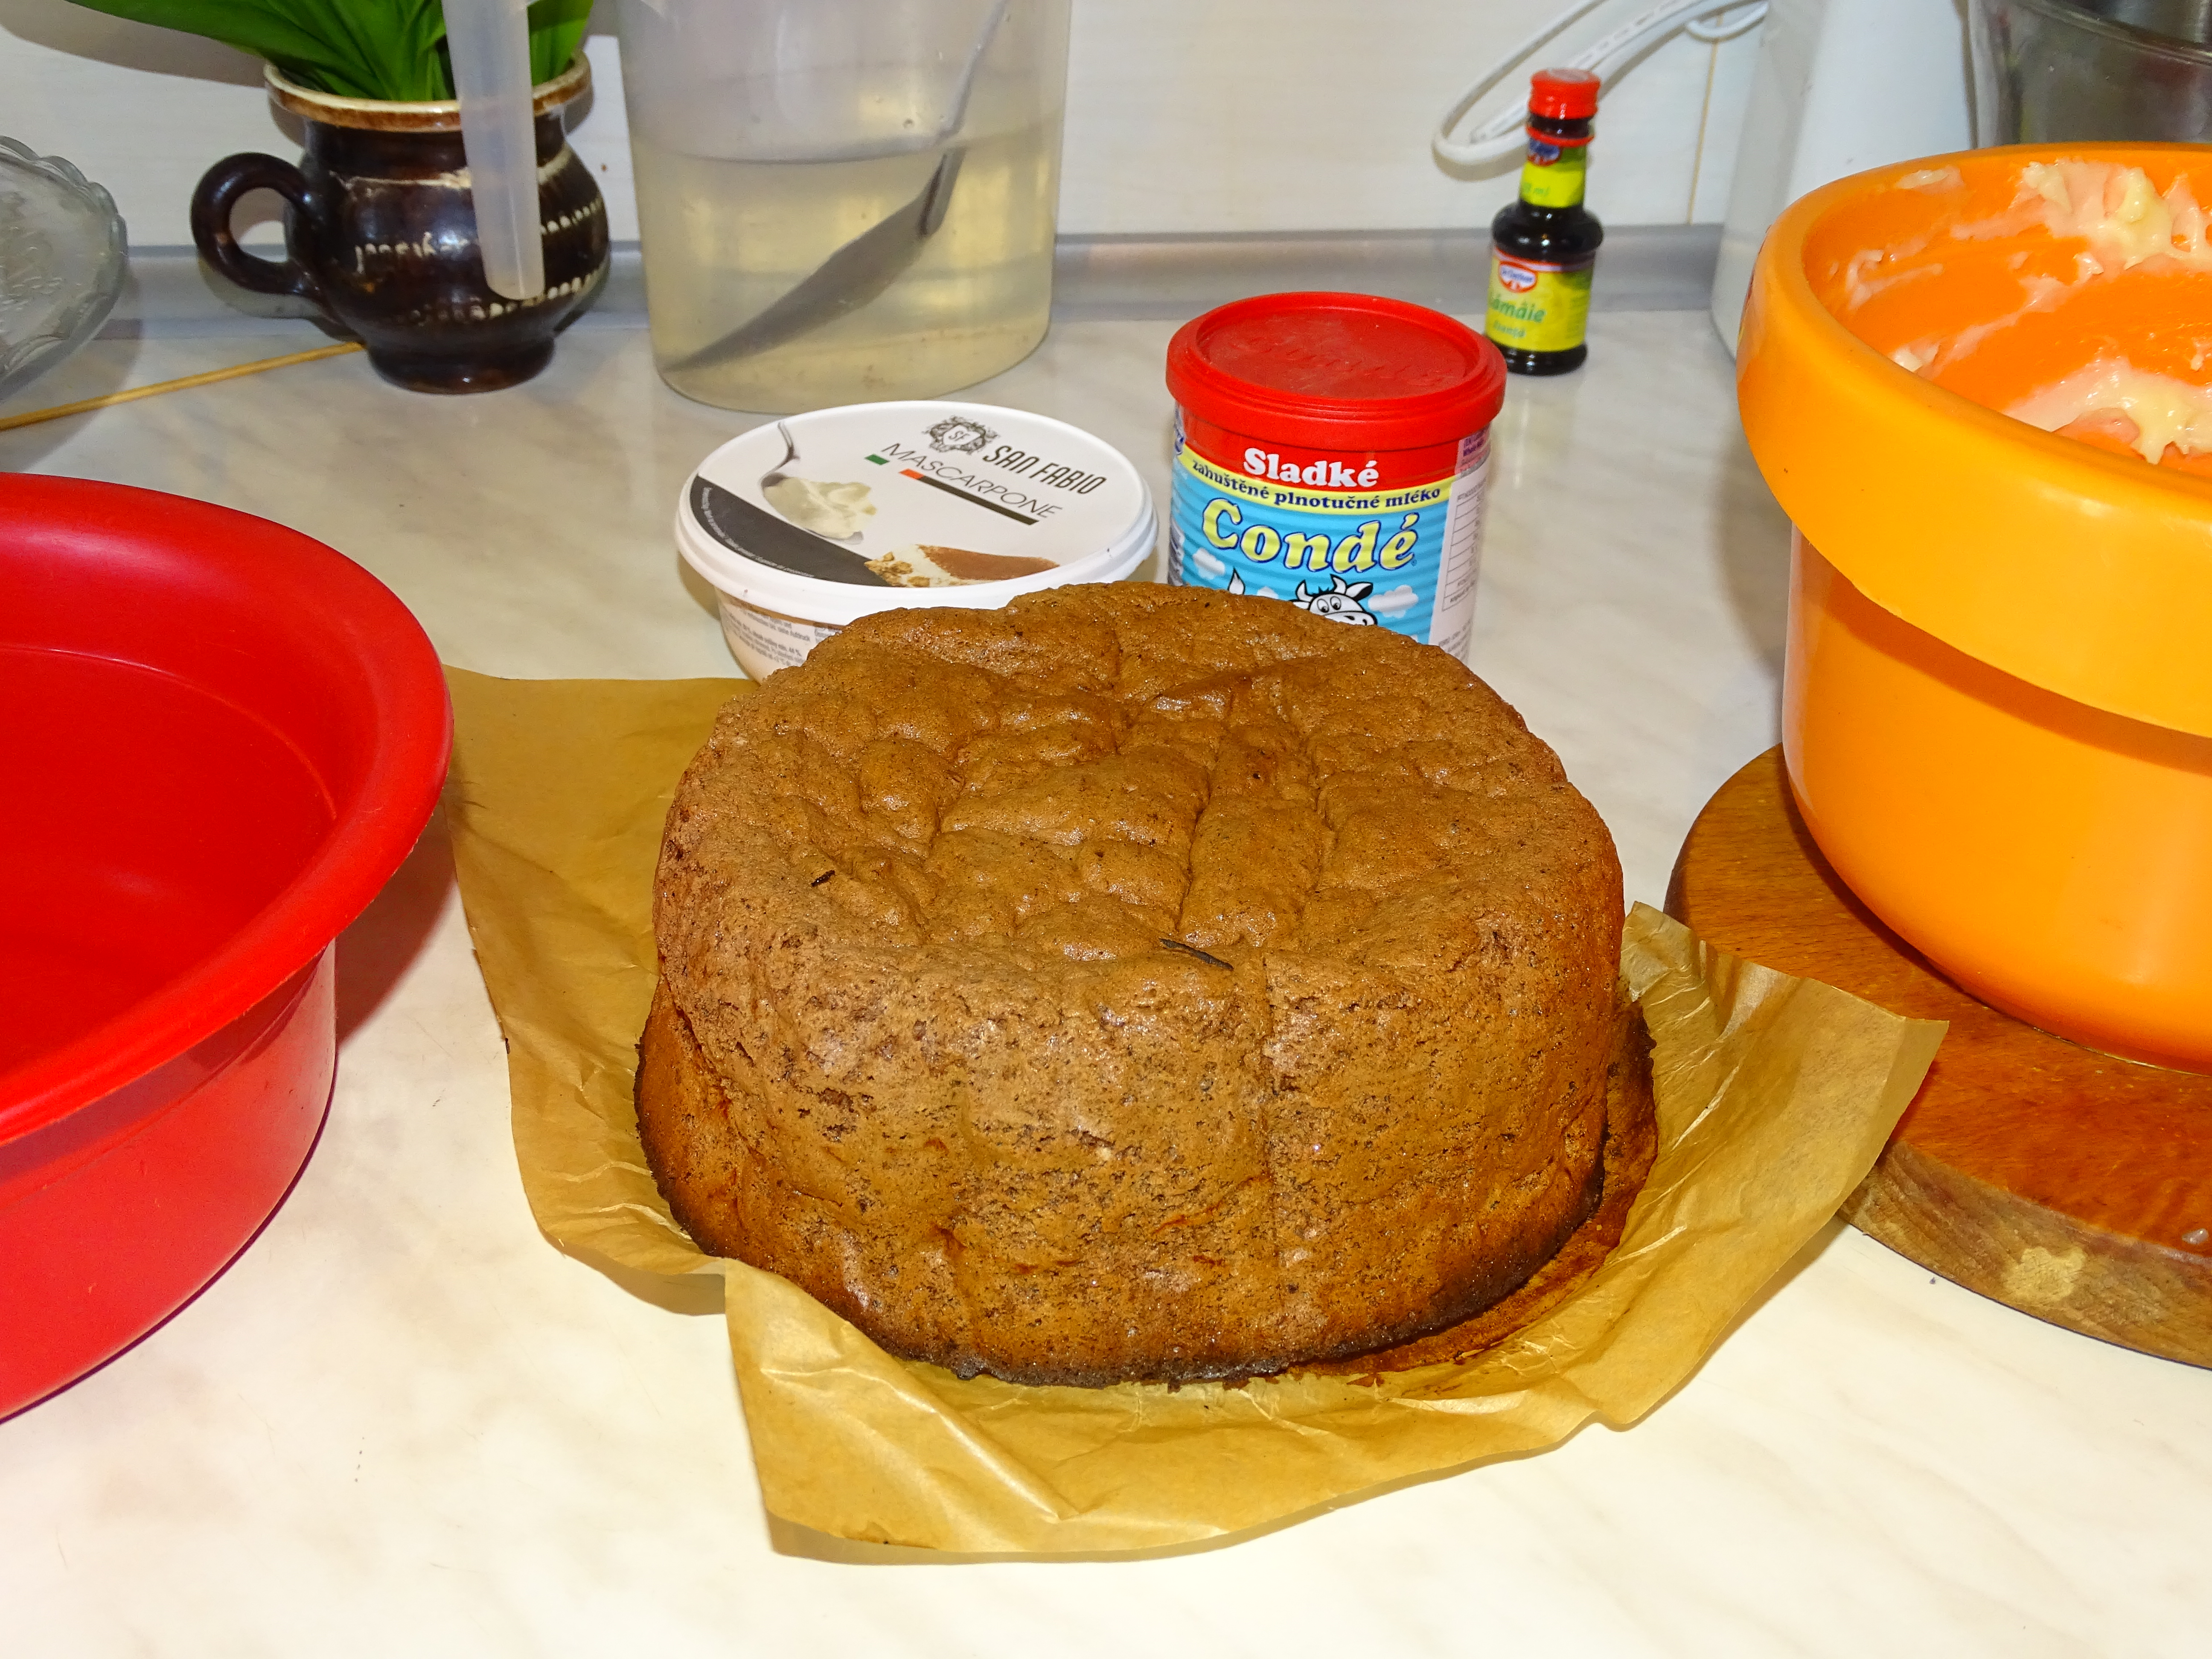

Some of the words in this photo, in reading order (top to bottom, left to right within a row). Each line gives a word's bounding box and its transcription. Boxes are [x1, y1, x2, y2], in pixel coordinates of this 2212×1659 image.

[881, 443, 1062, 518] MASCARPONE
[982, 445, 1040, 474] SAN
[1028, 462, 1107, 494] FABIO
[1193, 459, 1269, 499] zahuštěné
[1274, 492, 1380, 509] plnotučné
[1385, 488, 1440, 507] mléko
[1243, 448, 1379, 487] Sladké
[1202, 497, 1420, 573] Condé
